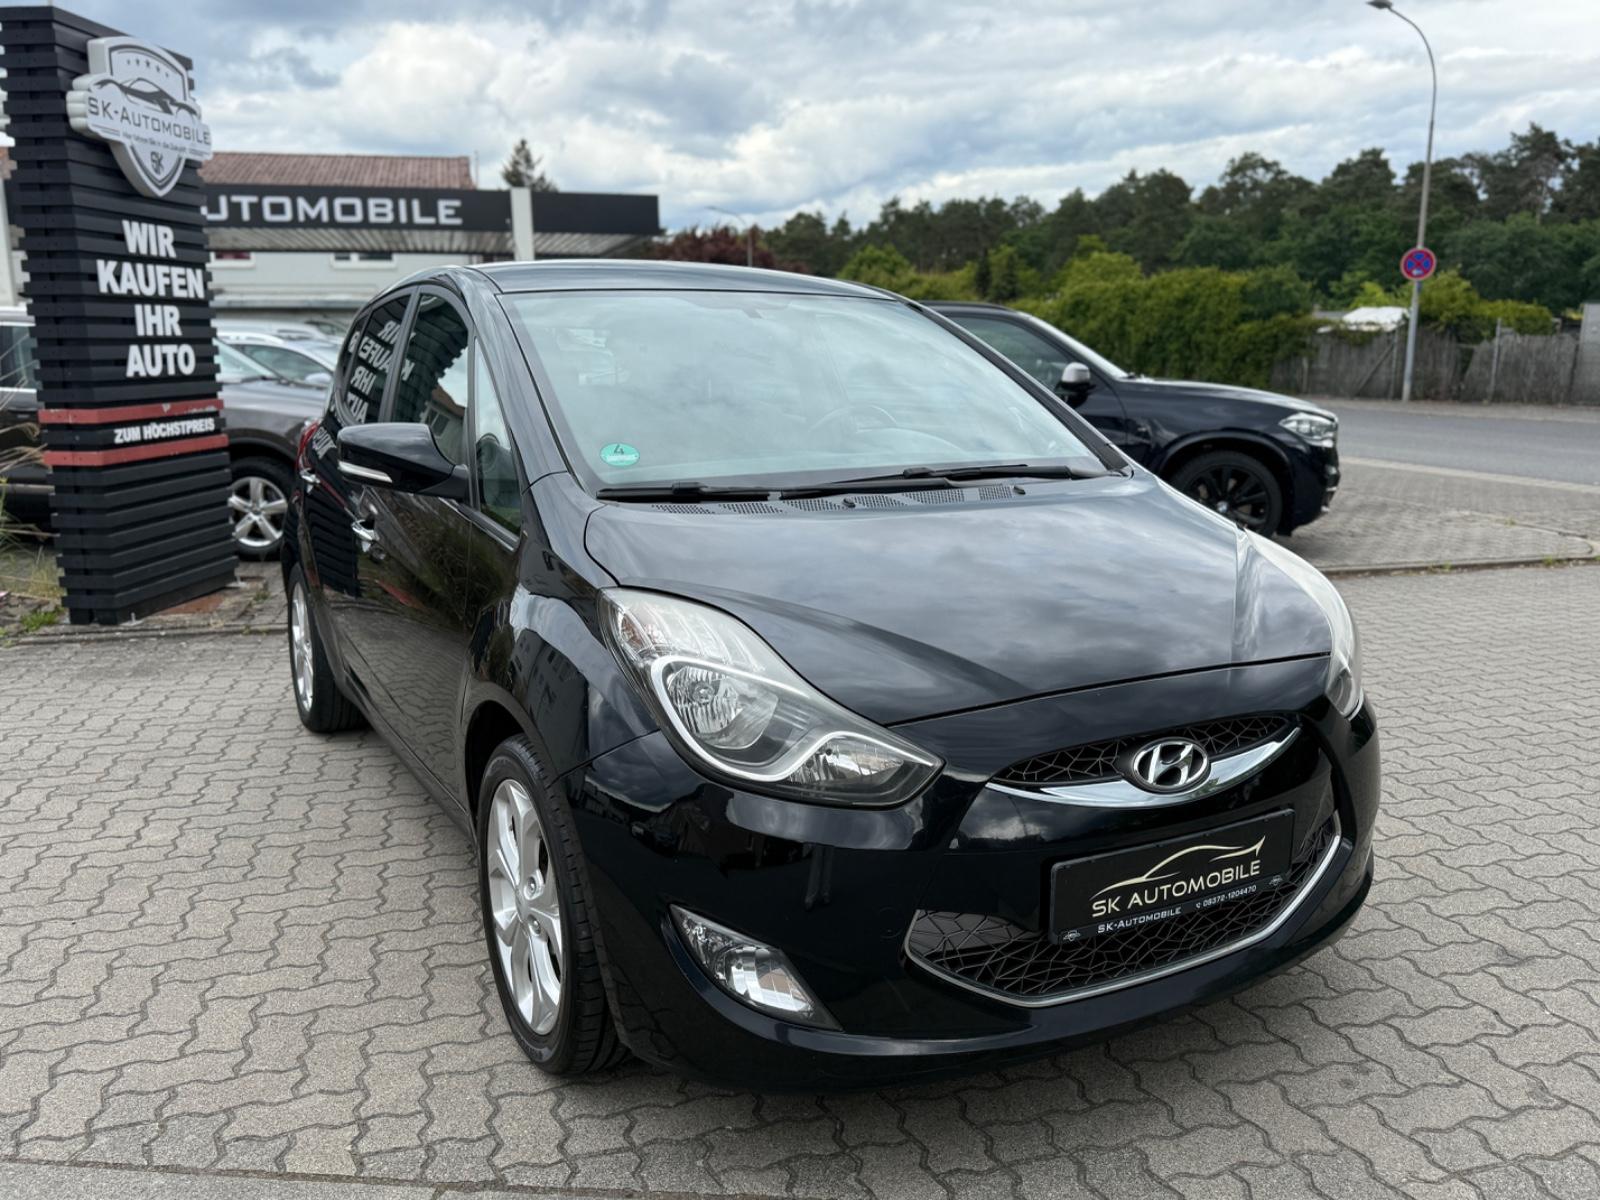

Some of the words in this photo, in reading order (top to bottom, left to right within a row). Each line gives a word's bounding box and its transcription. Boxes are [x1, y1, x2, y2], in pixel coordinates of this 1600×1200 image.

[87, 97, 211, 145] SK-AUTOMOBILE
[122, 220, 176, 258] WIR
[96, 259, 205, 298] KAUFEN
[134, 304, 182, 336] IHR
[126, 344, 196, 377] AUTO
[114, 426, 141, 443] ZUM
[1092, 896, 1121, 917] SK
[1127, 860, 1261, 909] AUTOMOBILE
[1097, 907, 1182, 934] SK-AUTOMOBILE
